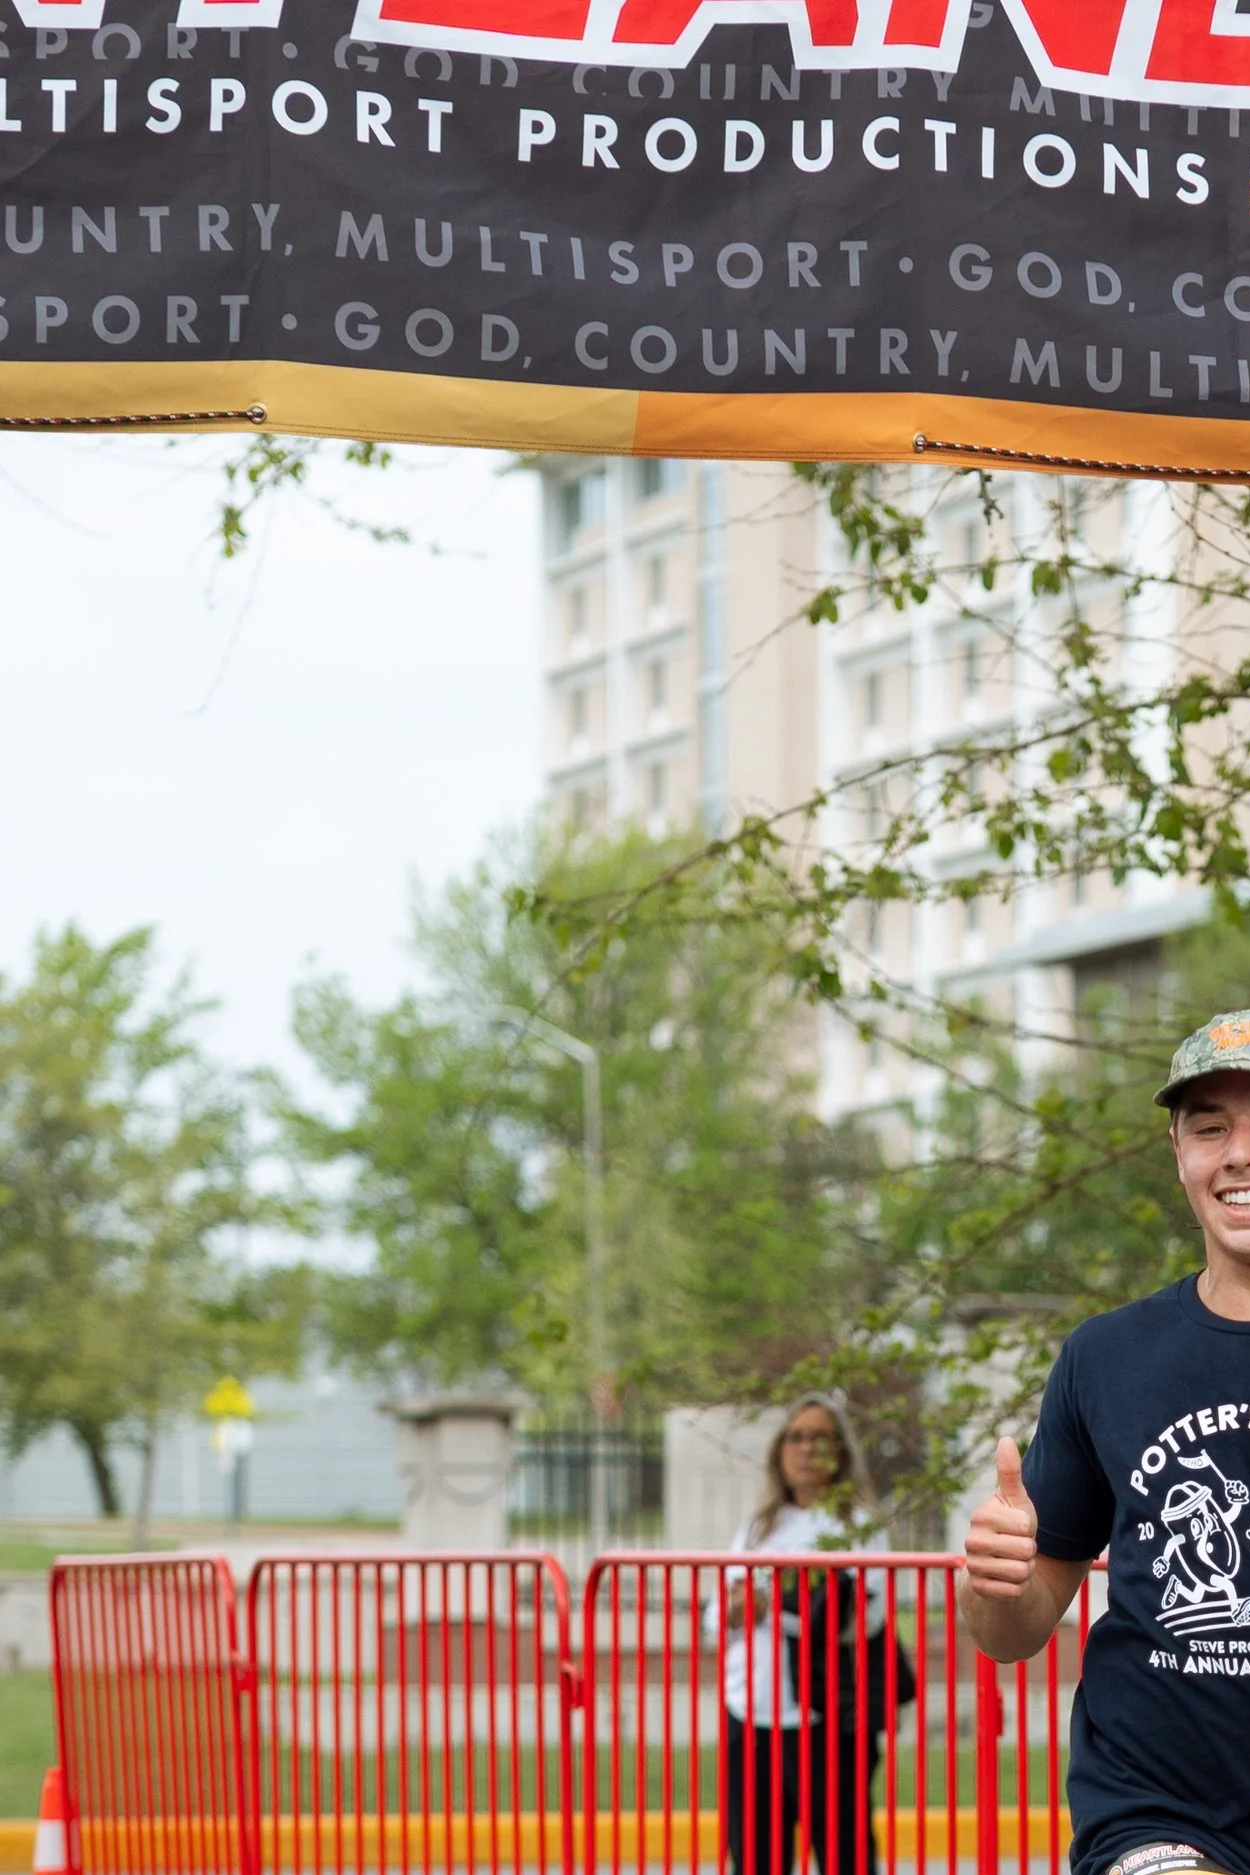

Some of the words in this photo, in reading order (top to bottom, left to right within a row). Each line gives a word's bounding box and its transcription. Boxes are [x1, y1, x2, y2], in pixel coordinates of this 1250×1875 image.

[518, 109, 1210, 205] PRODUCTIONS
[5, 202, 293, 256] UNTRY,
[336, 210, 868, 290] MULTISPORT
[949, 242, 1135, 313] GOD,
[334, 301, 532, 369] GOD,
[574, 321, 970, 382] COUNTRY,
[1137, 1521, 1155, 1542] 20
[1148, 1650, 1179, 1670] 4TH
[1189, 1639, 1225, 1654] STEVE
